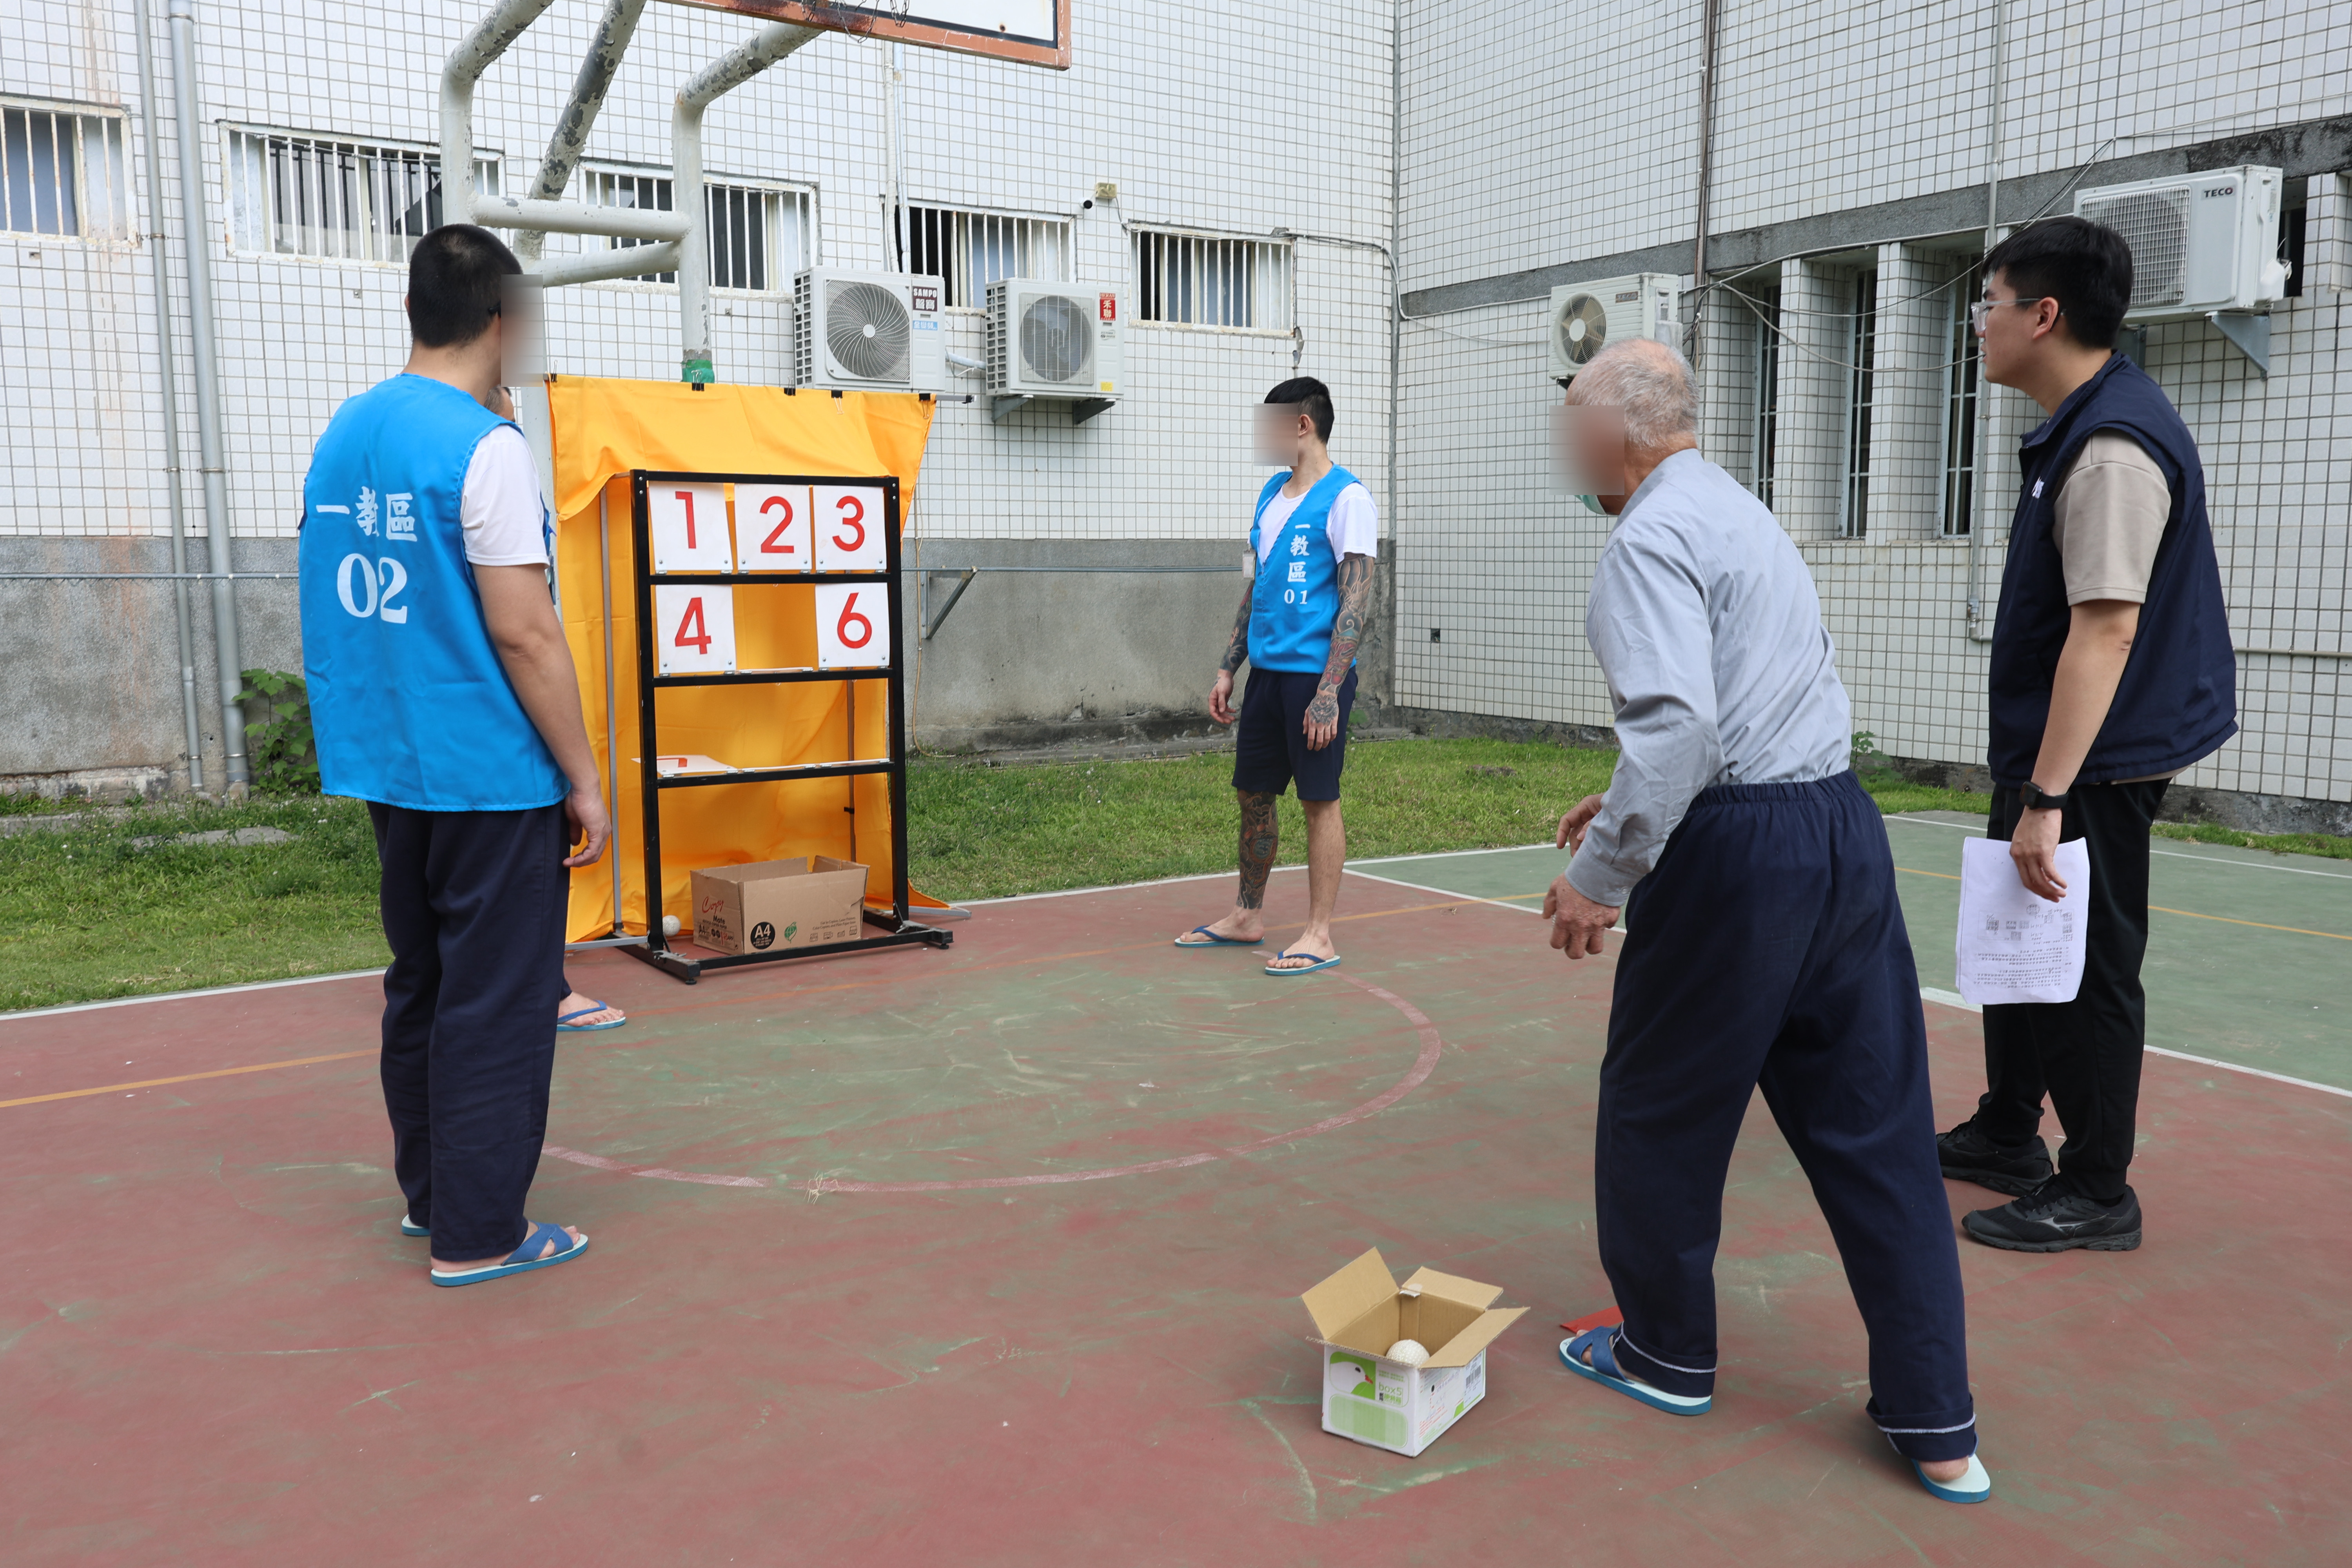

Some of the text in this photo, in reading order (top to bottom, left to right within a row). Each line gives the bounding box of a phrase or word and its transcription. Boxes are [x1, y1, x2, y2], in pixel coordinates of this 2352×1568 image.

[2204, 187, 2233, 198] TECO
[913, 288, 937, 298] SAMPO
[1103, 300, 1112, 318] 禾聯
[675, 491, 865, 553] 1 2 3
[1287, 524, 1310, 582] 一教區
[337, 553, 407, 624] 02
[1284, 589, 1308, 604] 01
[675, 592, 872, 655] 4 6
[702, 897, 724, 915] Copy
[713, 915, 726, 924] Mate
[755, 924, 771, 938] A4
[1379, 1382, 1402, 1396] box5
